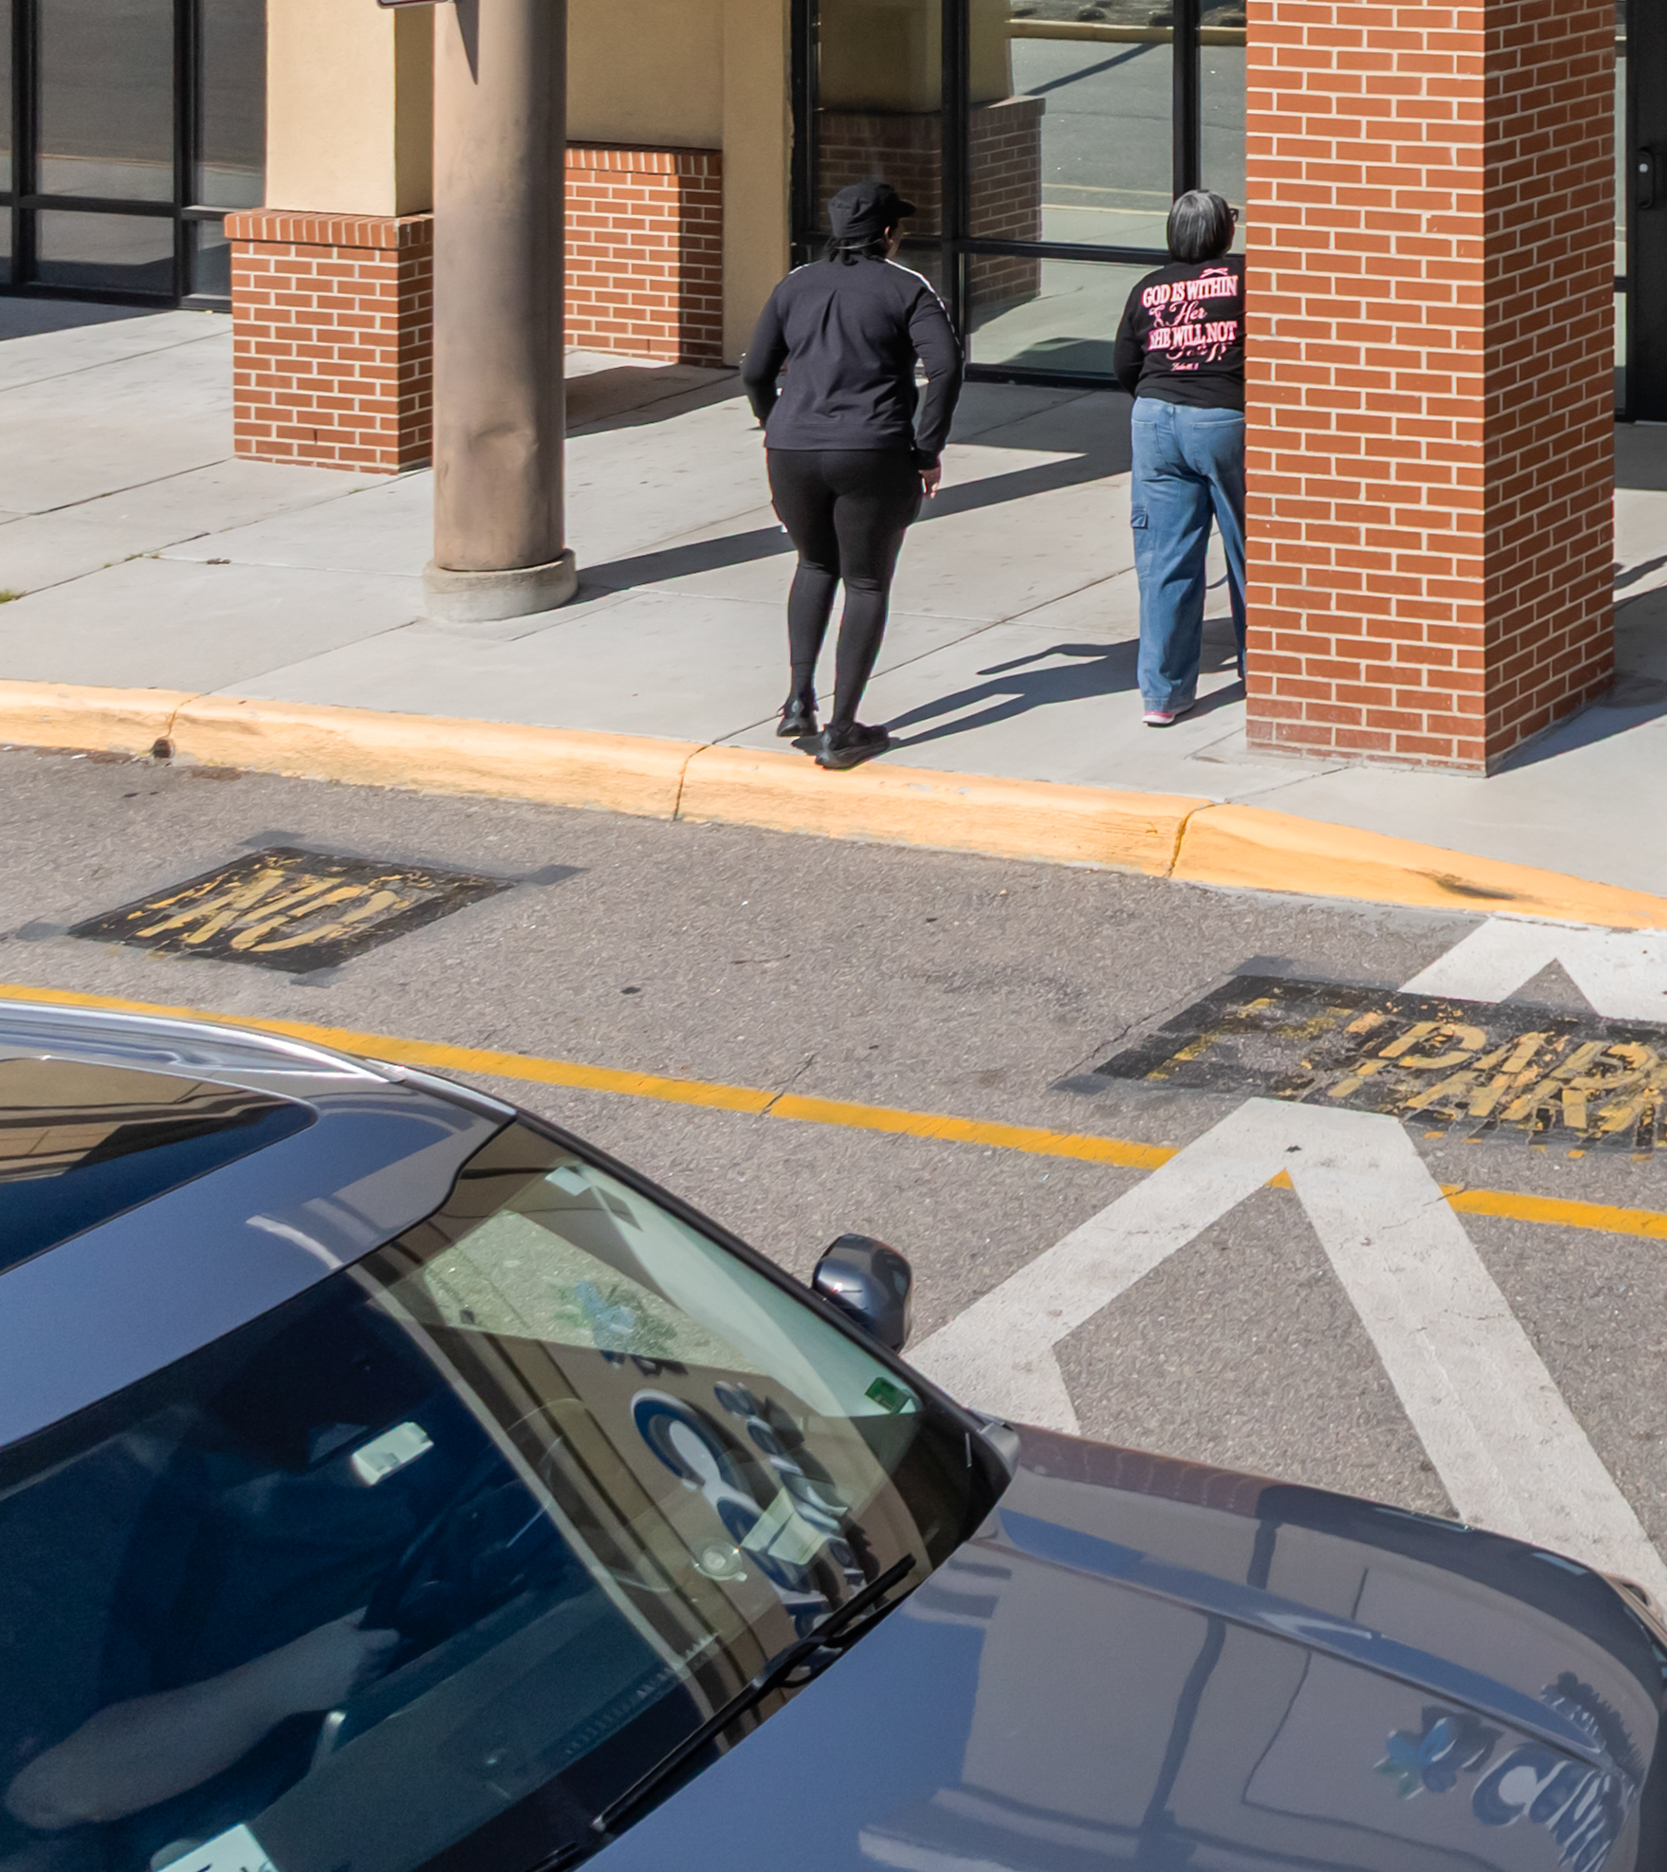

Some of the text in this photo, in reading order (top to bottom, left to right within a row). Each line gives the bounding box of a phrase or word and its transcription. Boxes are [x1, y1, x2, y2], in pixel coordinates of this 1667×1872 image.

[1142, 275, 1239, 308] GOD IS WITHIN
[1166, 300, 1207, 326] Her
[1172, 323, 1206, 347] WILL
[1205, 321, 1238, 343] NOT
